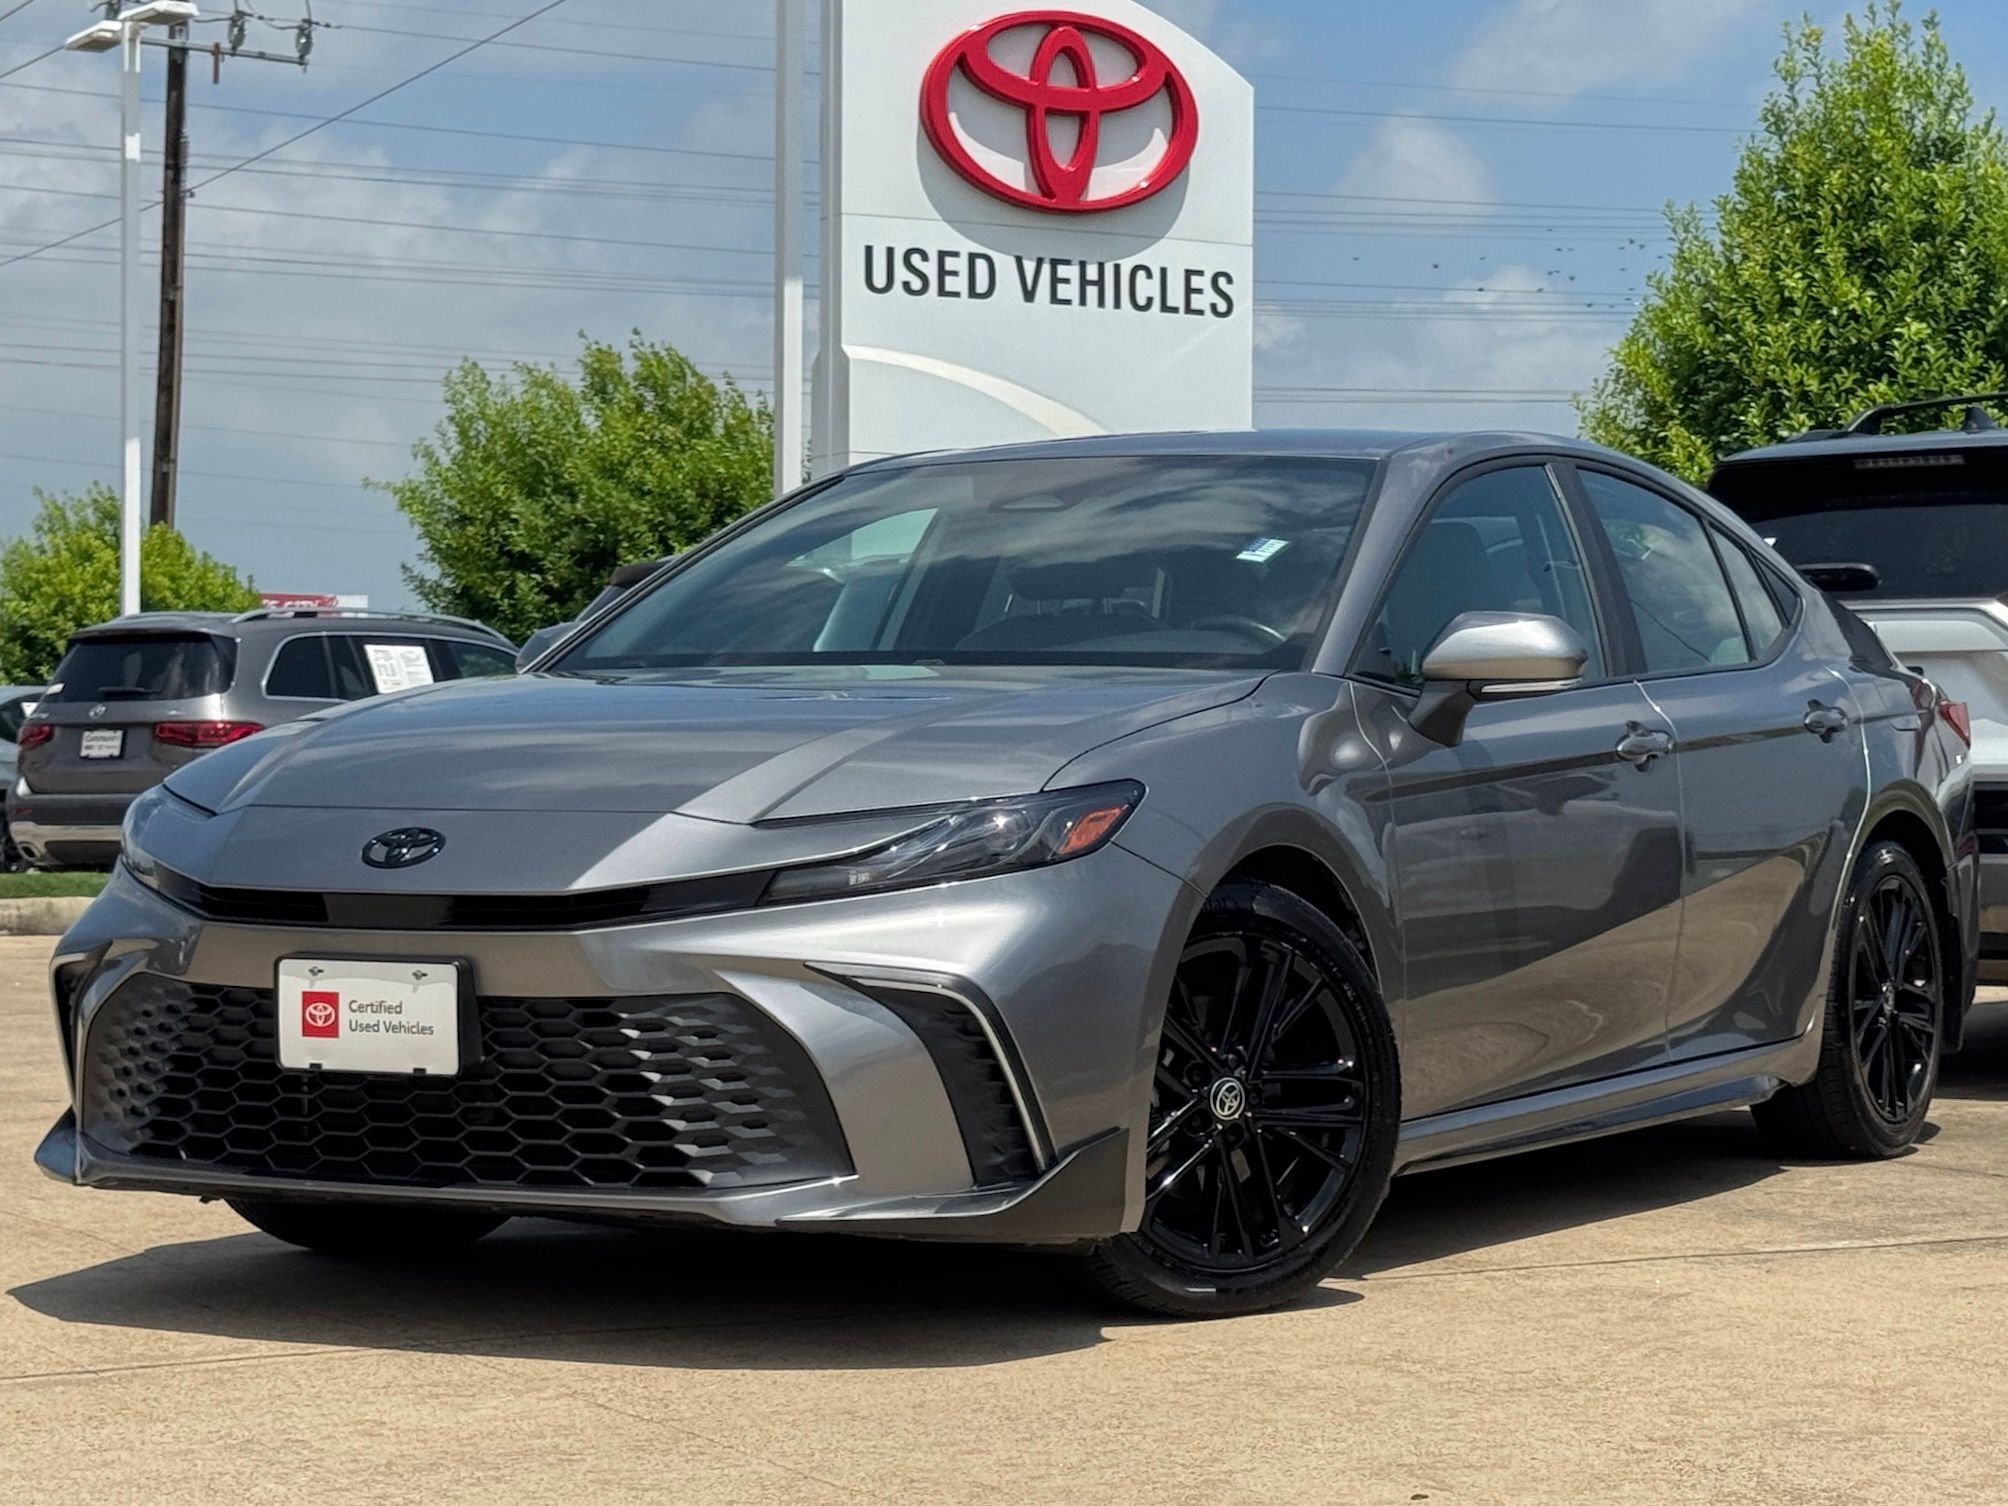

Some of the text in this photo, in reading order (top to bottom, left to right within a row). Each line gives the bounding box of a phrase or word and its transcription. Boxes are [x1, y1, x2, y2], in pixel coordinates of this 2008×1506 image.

[863, 245, 1235, 319] USED VEHICLES
[348, 999, 403, 1015] Certified
[348, 1019, 435, 1036] Used Vehicles
